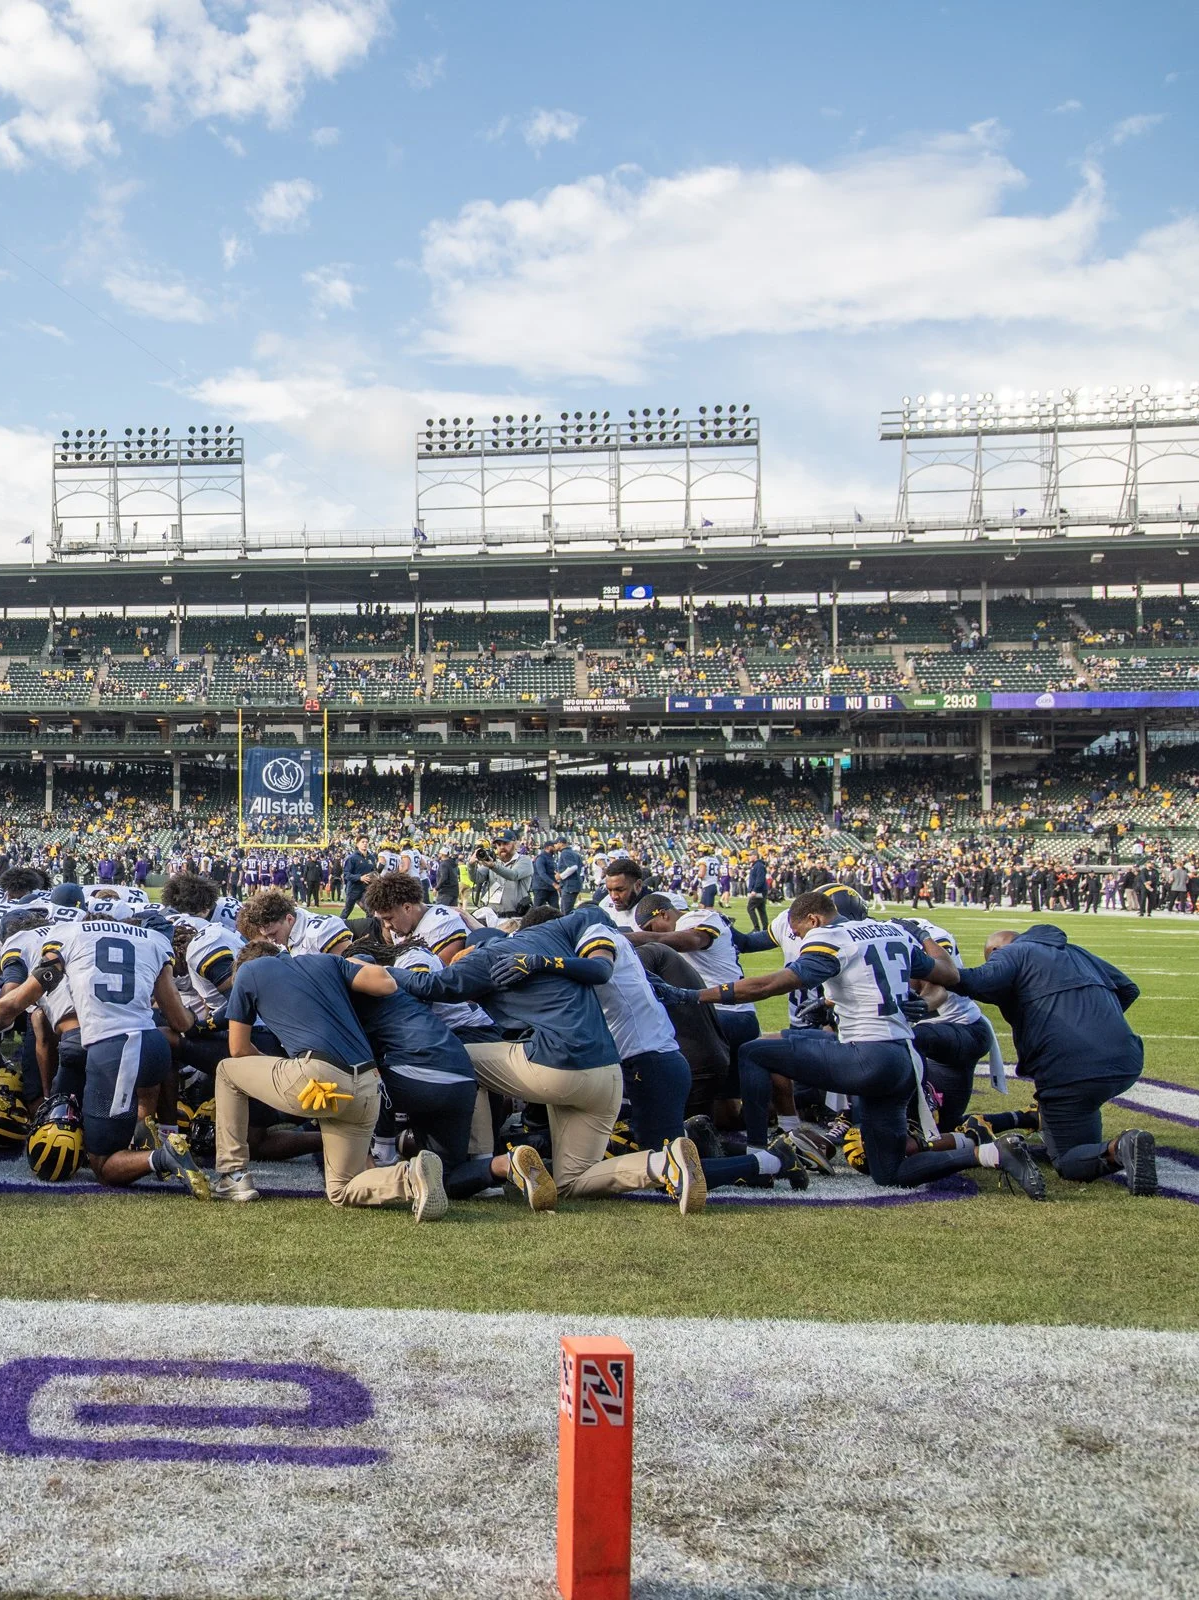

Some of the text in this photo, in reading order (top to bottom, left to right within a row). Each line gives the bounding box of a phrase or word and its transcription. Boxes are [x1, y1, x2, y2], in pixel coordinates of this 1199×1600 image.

[305, 699, 319, 711] 25
[772, 697, 819, 710] MICH 0
[845, 697, 880, 709] NU 0
[943, 695, 977, 708] 29:03
[249, 796, 314, 816] Allstate
[81, 922, 149, 939] GOODWIN
[846, 924, 904, 943] ANDERSON
[94, 936, 136, 1005] 9
[554, 957, 565, 969] M
[864, 941, 911, 1017] 13
[580, 1359, 625, 1426] N
